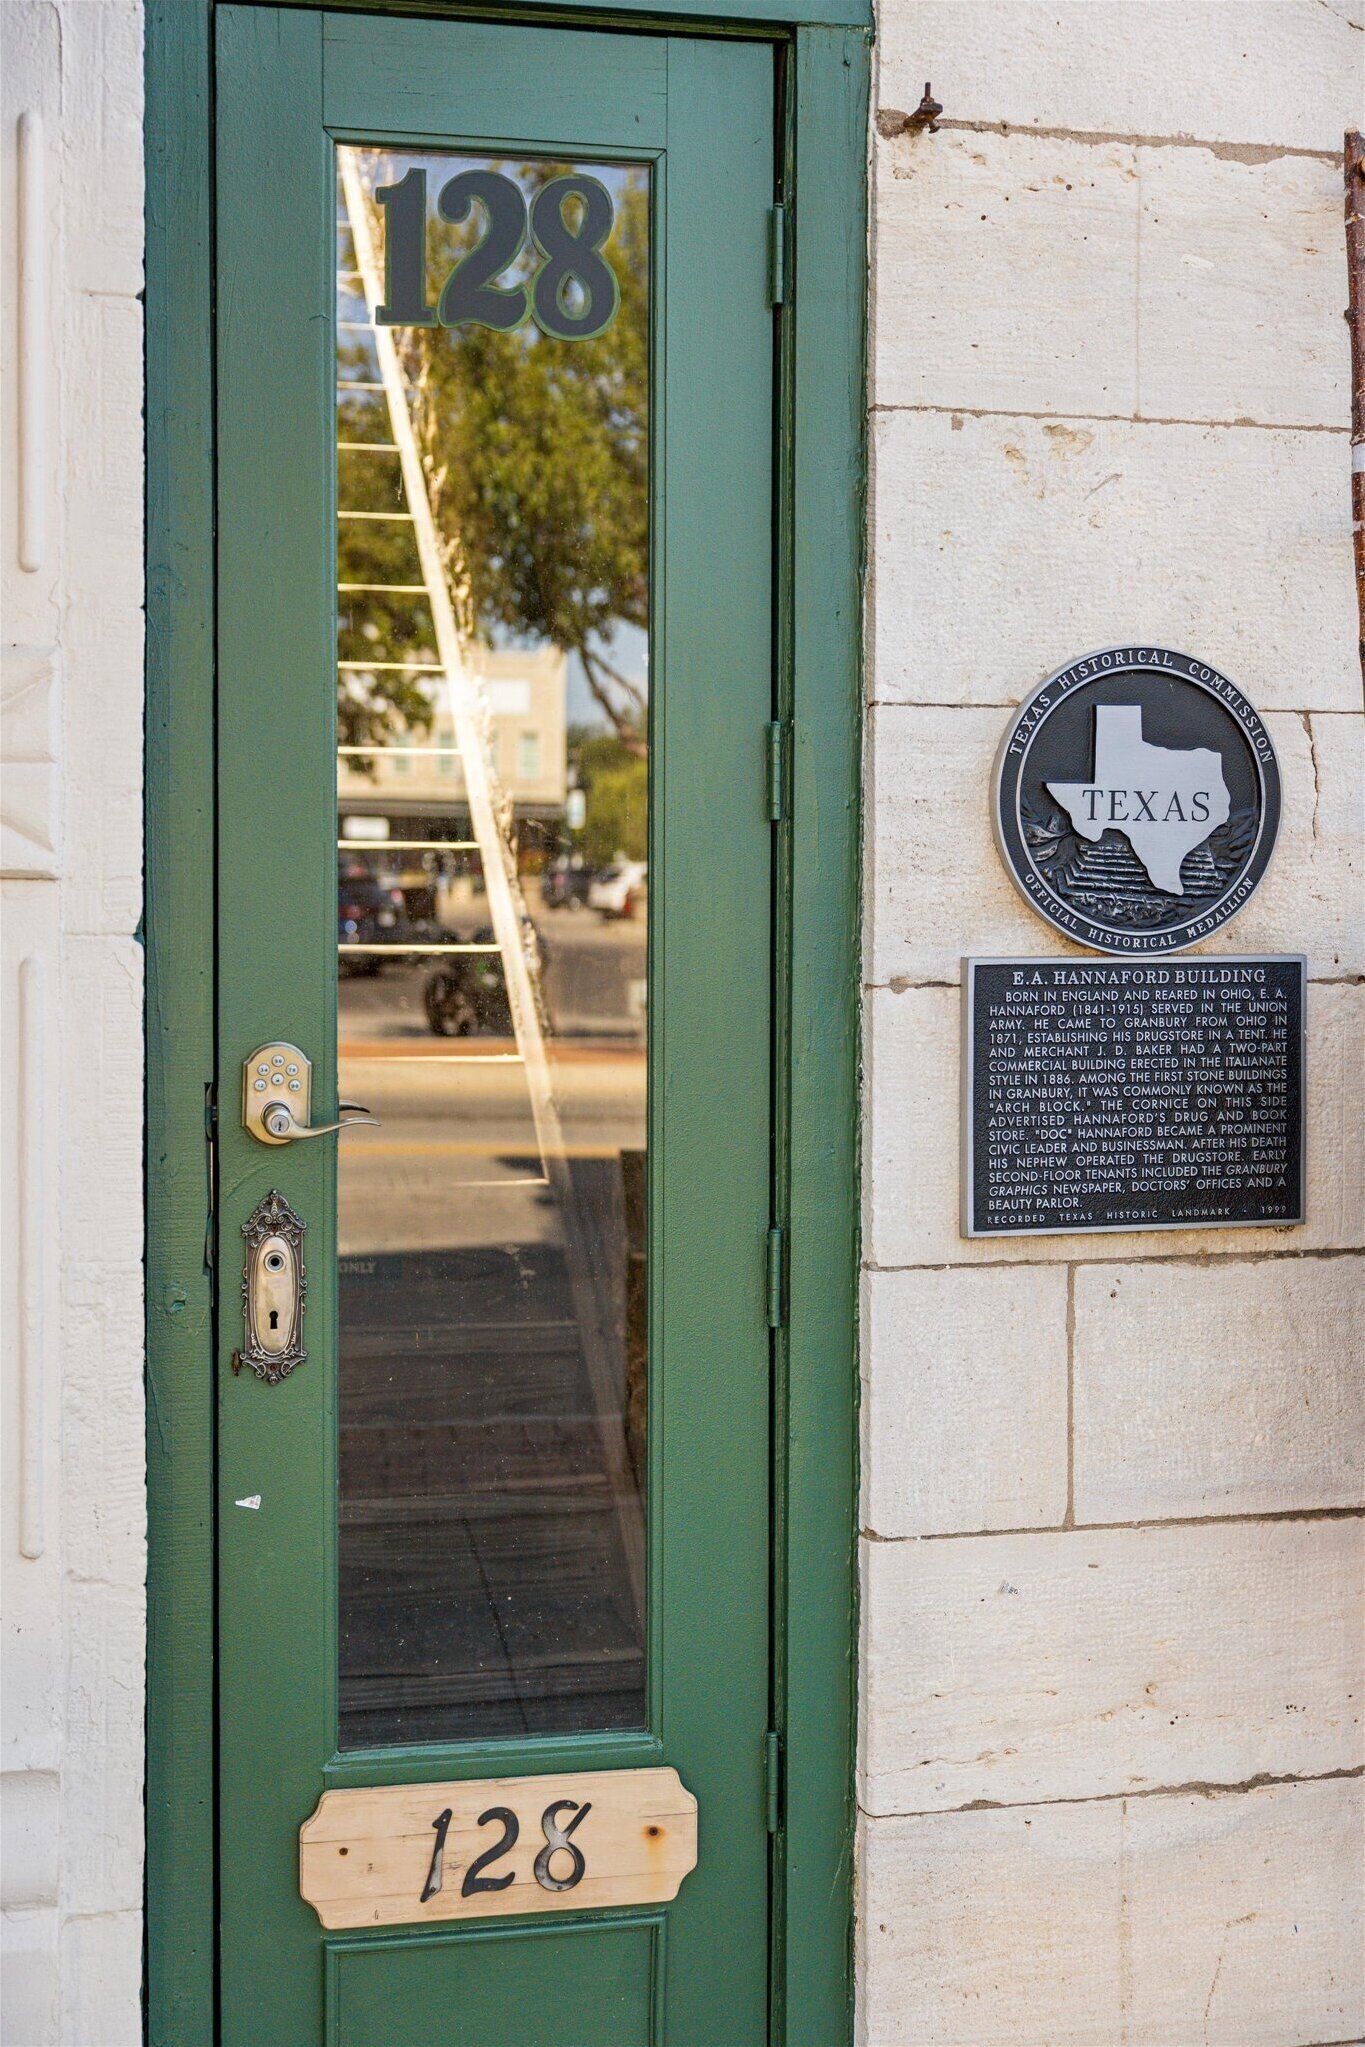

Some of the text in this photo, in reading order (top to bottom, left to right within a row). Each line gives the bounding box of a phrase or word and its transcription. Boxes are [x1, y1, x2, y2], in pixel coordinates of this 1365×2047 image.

[375, 167, 621, 342] 128
[1009, 650, 1273, 764] TEXAS HISTORICAL COMMISSION
[1082, 790, 1210, 822] TEXAS
[1024, 873, 1254, 949] OFFICIAL HISTORICAL MEDALLION
[1012, 968, 1266, 986] E.A. HANNAFORD BUILDING
[1005, 988, 1286, 1003] BORN IN ENGLAND AND REARED IN OHIO, E. A.
[989, 1001, 1287, 1016] HANNAFORD (1841-1915) SERVED IN THE UNION
[988, 1015, 1287, 1031] ARMY. HE CAME TO GRANBURY FROM OHIO IN
[990, 1028, 1287, 1046] 1871, ESTABLISHING HIS DRUGSTORE IN A TENT. HE
[988, 1042, 1287, 1058] AND MERCHANT J. D. BAKER HAD A TWO-PART
[988, 1055, 1287, 1072] COMMERCIAL BUILDING ERECTED IN THE ITALIANATE
[989, 1069, 1287, 1086] STYLE IN 1886. AMONG THE FIRST STONE BUILDINGS
[989, 1082, 1286, 1101] IN GRANBURY, IT WAS COMMONLY KNOWN AS THE
[1100, 1099, 1122, 1111] THE
[1131, 1098, 1188, 1110] CORNICE
[1197, 1097, 1216, 1108] ON
[1225, 1096, 1251, 1108] THIS
[1258, 1096, 1286, 1107] SIDE
[988, 1114, 1064, 1128] ADVERTISED
[1174, 1111, 1208, 1123] DRUG
[1216, 1110, 1243, 1122] AND
[1252, 1109, 1287, 1121] BOOK
[988, 1129, 1028, 1141] STORE.
[1077, 1126, 1152, 1139] HANNAFORD
[1157, 1125, 1202, 1136] BECAME
[1207, 1124, 1216, 1135] A
[1221, 1122, 1287, 1135] PROMINENT
[988, 1136, 1286, 1155] CIVIC LEADER AND BUSINESSMAN. AFTER HIS DEATH
[988, 1149, 1286, 1169] HIS NEPHEW OPERATED THE DRUGSTORE. EARLY
[988, 1162, 1287, 1183] SECOND-FLOOR TENANTS INCLUDED THE GRANBURY
[988, 1184, 1047, 1197] GRAPHICS
[1053, 1181, 1125, 1196] NEWSPAPER,
[1195, 1178, 1241, 1190] OFFICES
[1246, 1176, 1272, 1188] AND
[1276, 1176, 1286, 1187] A
[988, 1197, 1082, 1210] BEAUTY PARLOR.
[987, 1205, 1286, 1224] RECORDED TEXAS HISTORIC LANDMARK 1999
[420, 1800, 593, 1903] 128
